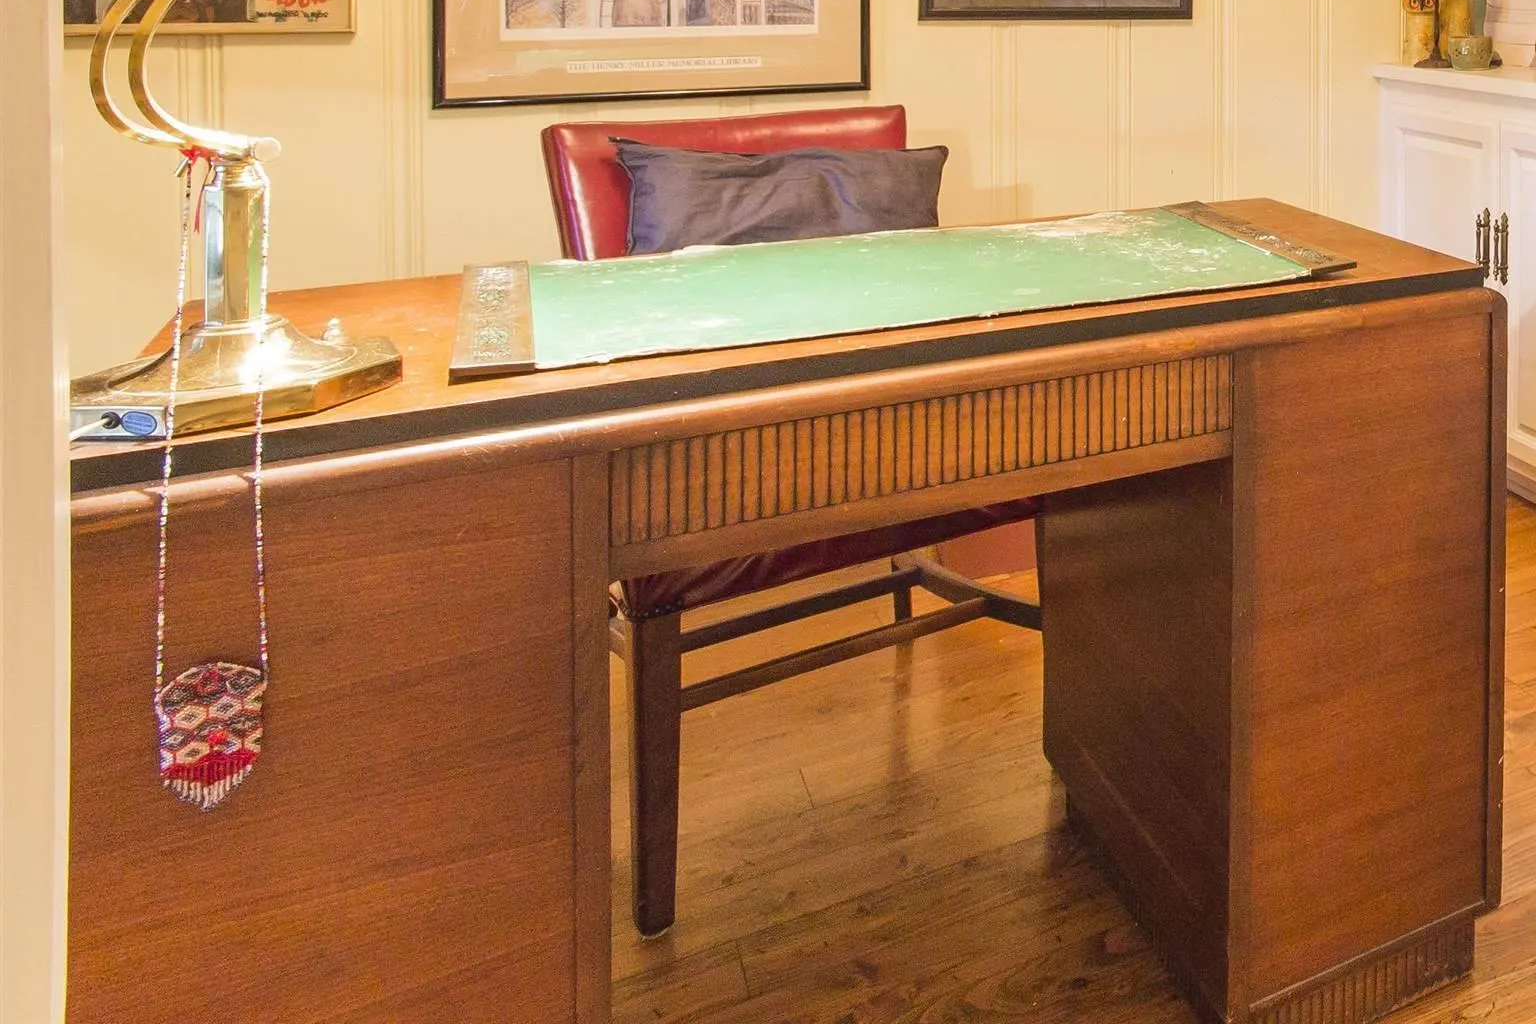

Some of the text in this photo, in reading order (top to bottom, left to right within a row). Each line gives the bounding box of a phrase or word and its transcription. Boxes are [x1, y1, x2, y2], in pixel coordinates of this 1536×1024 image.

[568, 58, 758, 71] THE HENRY MILLER MEMORIAL LIBRARY
